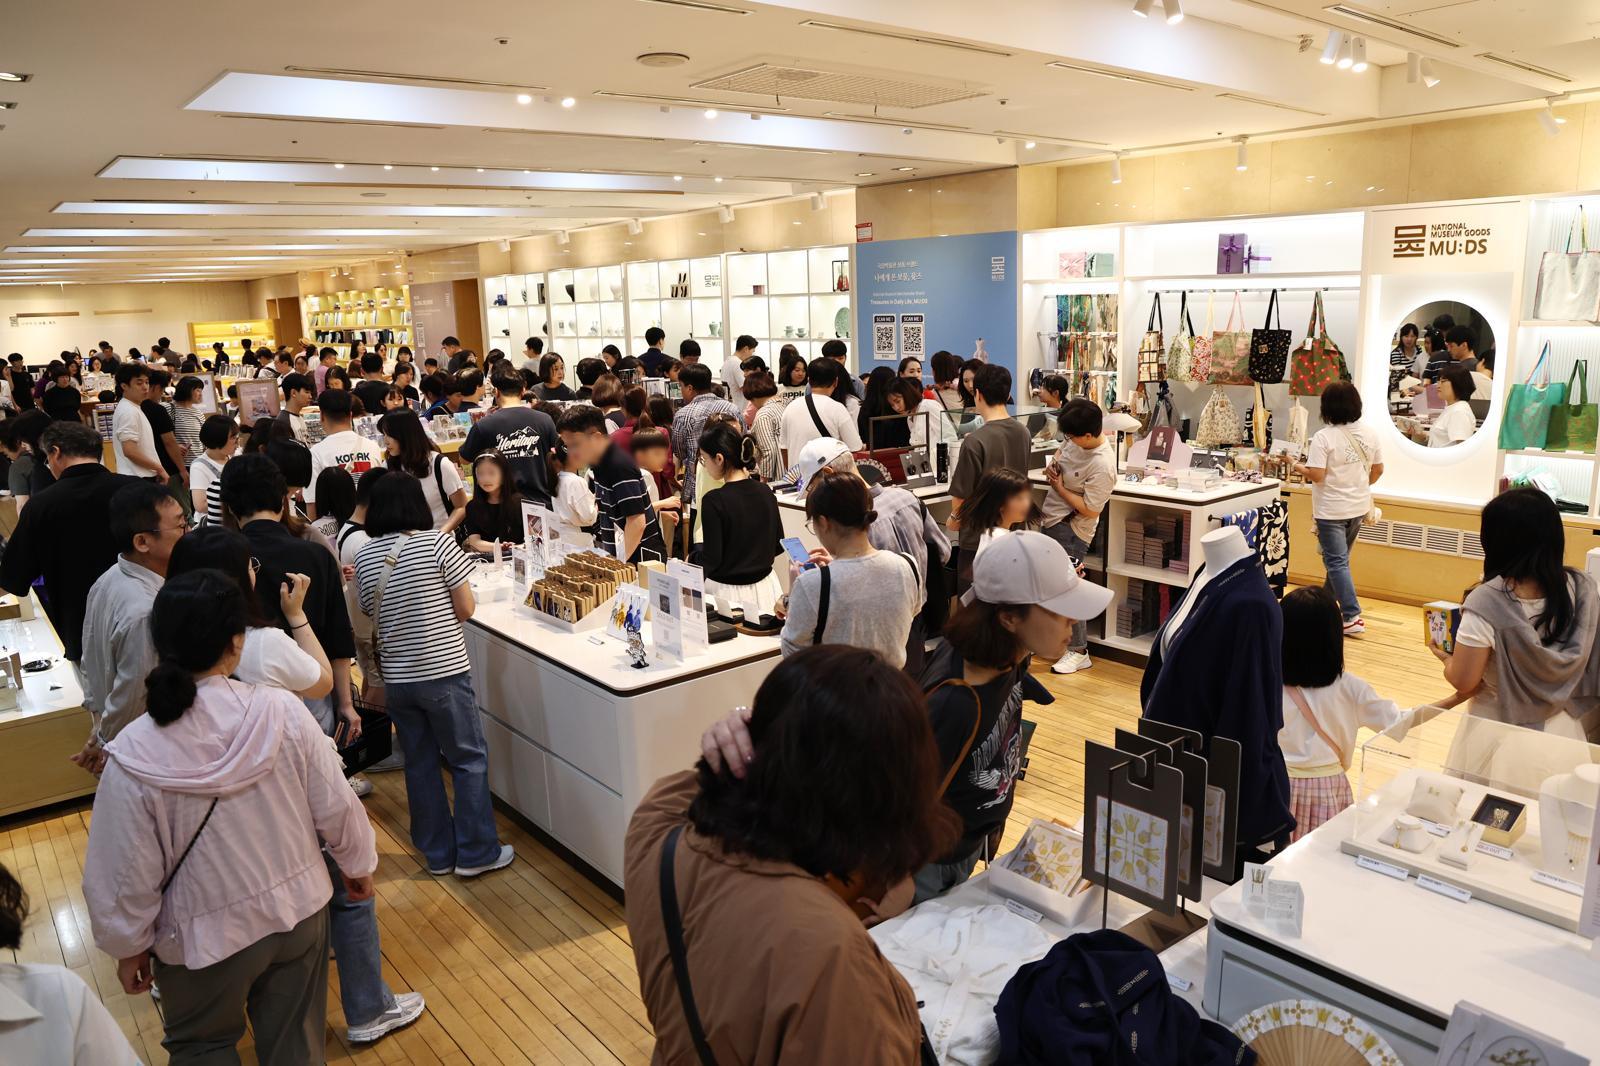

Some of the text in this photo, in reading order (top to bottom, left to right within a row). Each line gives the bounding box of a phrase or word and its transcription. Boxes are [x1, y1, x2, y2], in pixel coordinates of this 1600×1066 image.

[1431, 223, 1467, 231] NATIONAL
[1431, 228, 1490, 238] MUSEUM GOODS
[1429, 239, 1488, 256] MU:DS
[496, 435, 539, 451] Heritage
